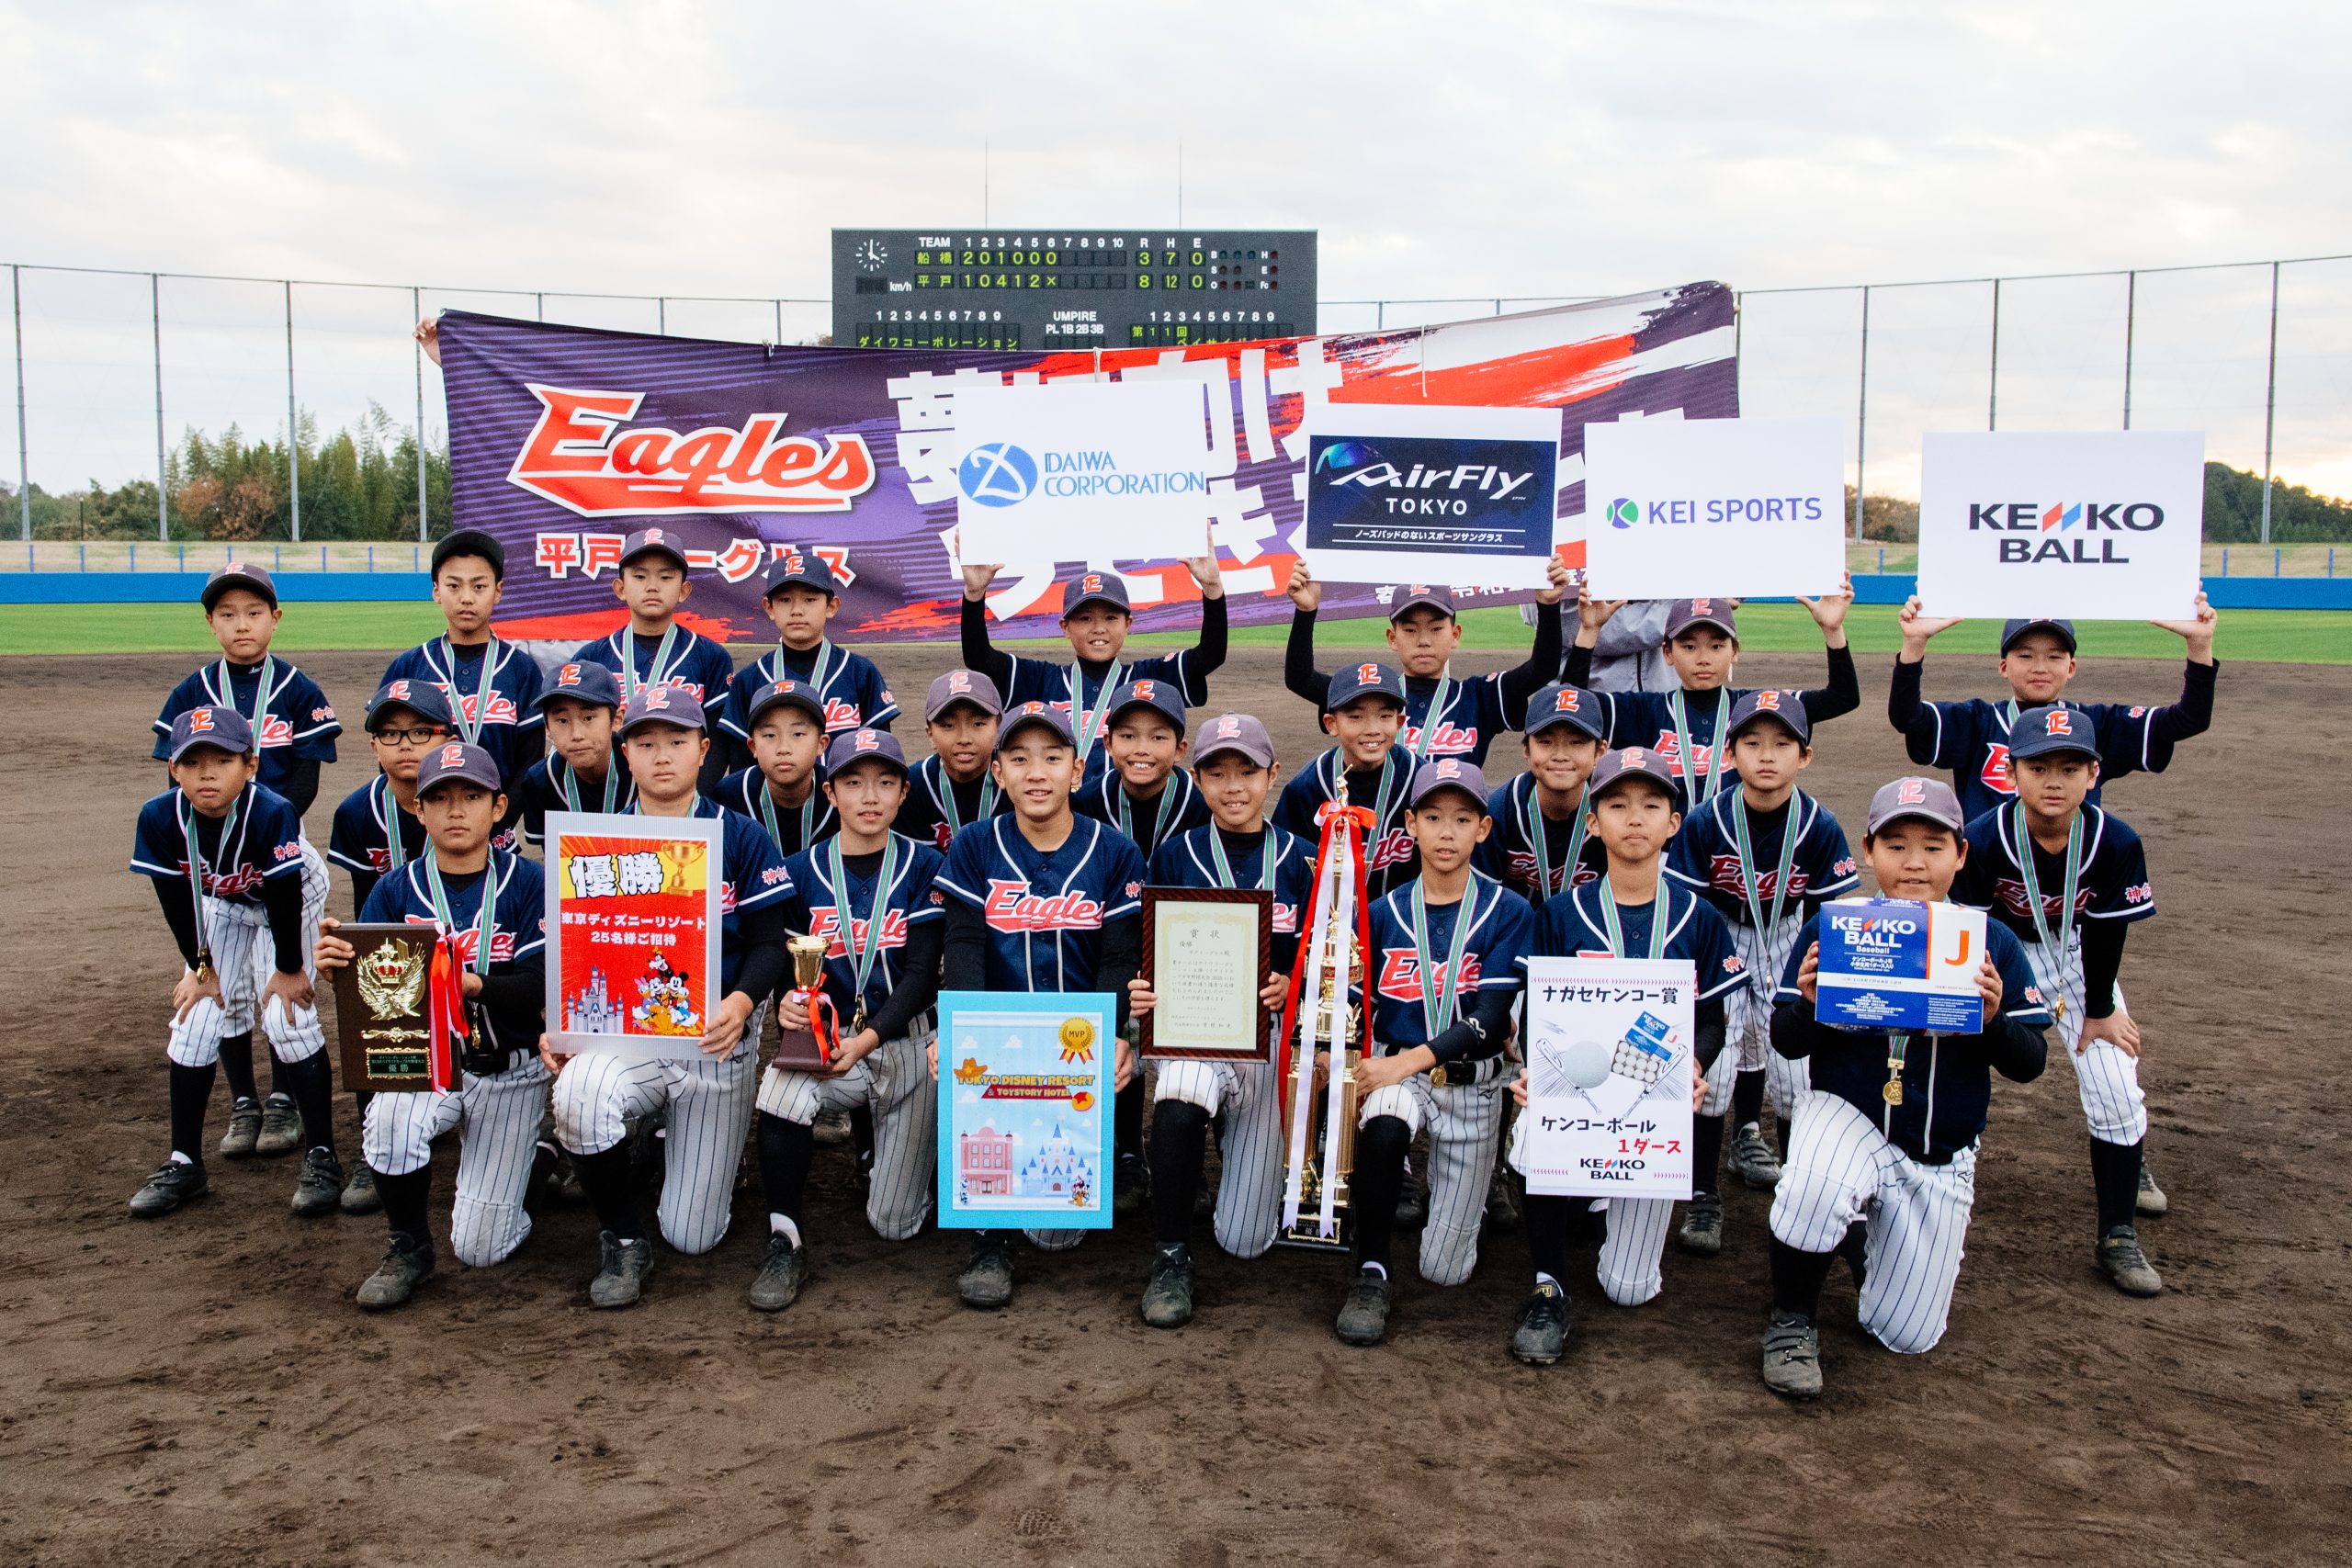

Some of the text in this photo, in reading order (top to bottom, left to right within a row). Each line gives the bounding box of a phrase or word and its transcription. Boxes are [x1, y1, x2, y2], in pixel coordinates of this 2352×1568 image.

[919, 237, 1202, 248] TEAM 1 2 3 4 5 6 7 8 9 10 R H E
[917, 252, 1203, 265] 船橋 2 0 1 0 0 0 3 7 0
[889, 280, 912, 292] km/h
[917, 275, 952, 288] 平戸
[965, 275, 972, 288] 1
[979, 275, 990, 288] 0
[996, 275, 1007, 288] 4
[1014, 275, 1021, 288] 1
[1029, 275, 1040, 288] 2
[1139, 275, 1149, 288] 8
[1165, 275, 1178, 288] 12
[1193, 275, 1203, 288] 0
[876, 310, 1001, 321] 1 2 3 4 5 6 7 8 9
[1053, 310, 1097, 321] UMPIRE
[1150, 311, 1275, 321] 1 2 3 4 5 6 7 8 9
[1046, 324, 1104, 334] PL 1B 2B 3B
[859, 336, 1018, 348] ダイワコーポレーション
[506, 383, 876, 517] Eagles
[1044, 450, 1116, 472] DAIWA
[1044, 470, 1204, 497] CORPORATION
[1329, 462, 1534, 500] AirFly
[1385, 498, 1467, 516] TOKYO
[1648, 497, 1823, 525] KEI SPORTS
[1999, 538, 2130, 564] BALL
[785, 555, 805, 577] E
[1082, 575, 1103, 595] E
[559, 663, 582, 687] E
[949, 671, 972, 695] E
[1358, 663, 1382, 685] E
[389, 681, 412, 701] E
[645, 687, 670, 712] E
[1132, 681, 1156, 700] E
[1556, 690, 1580, 713] E
[1756, 691, 1781, 711] E
[190, 708, 215, 734] E
[1217, 716, 1241, 739] E
[2045, 711, 2073, 737] E
[854, 729, 879, 751] E
[441, 744, 465, 769] E
[1621, 748, 1647, 770] E
[1436, 758, 1462, 779] E
[1898, 779, 1926, 806] E
[568, 851, 665, 898] 優勝
[560, 912, 706, 930] 東京ディズニーリゾート
[591, 931, 677, 946] 25名様ご招待
[1845, 931, 1902, 948] BALL
[1945, 930, 1970, 966] J
[1543, 986, 1678, 1005] ナガセケンコー賞
[1001, 1075, 1046, 1086] DISNEY
[1047, 1075, 1095, 1086] RESORT
[996, 1089, 1044, 1097] TOYSTORY
[1044, 1089, 1071, 1097] HOTEL
[1542, 1116, 1657, 1134] ケンコーボール
[1618, 1137, 1681, 1156] 1ダース
[1590, 1170, 1634, 1181] BALL
